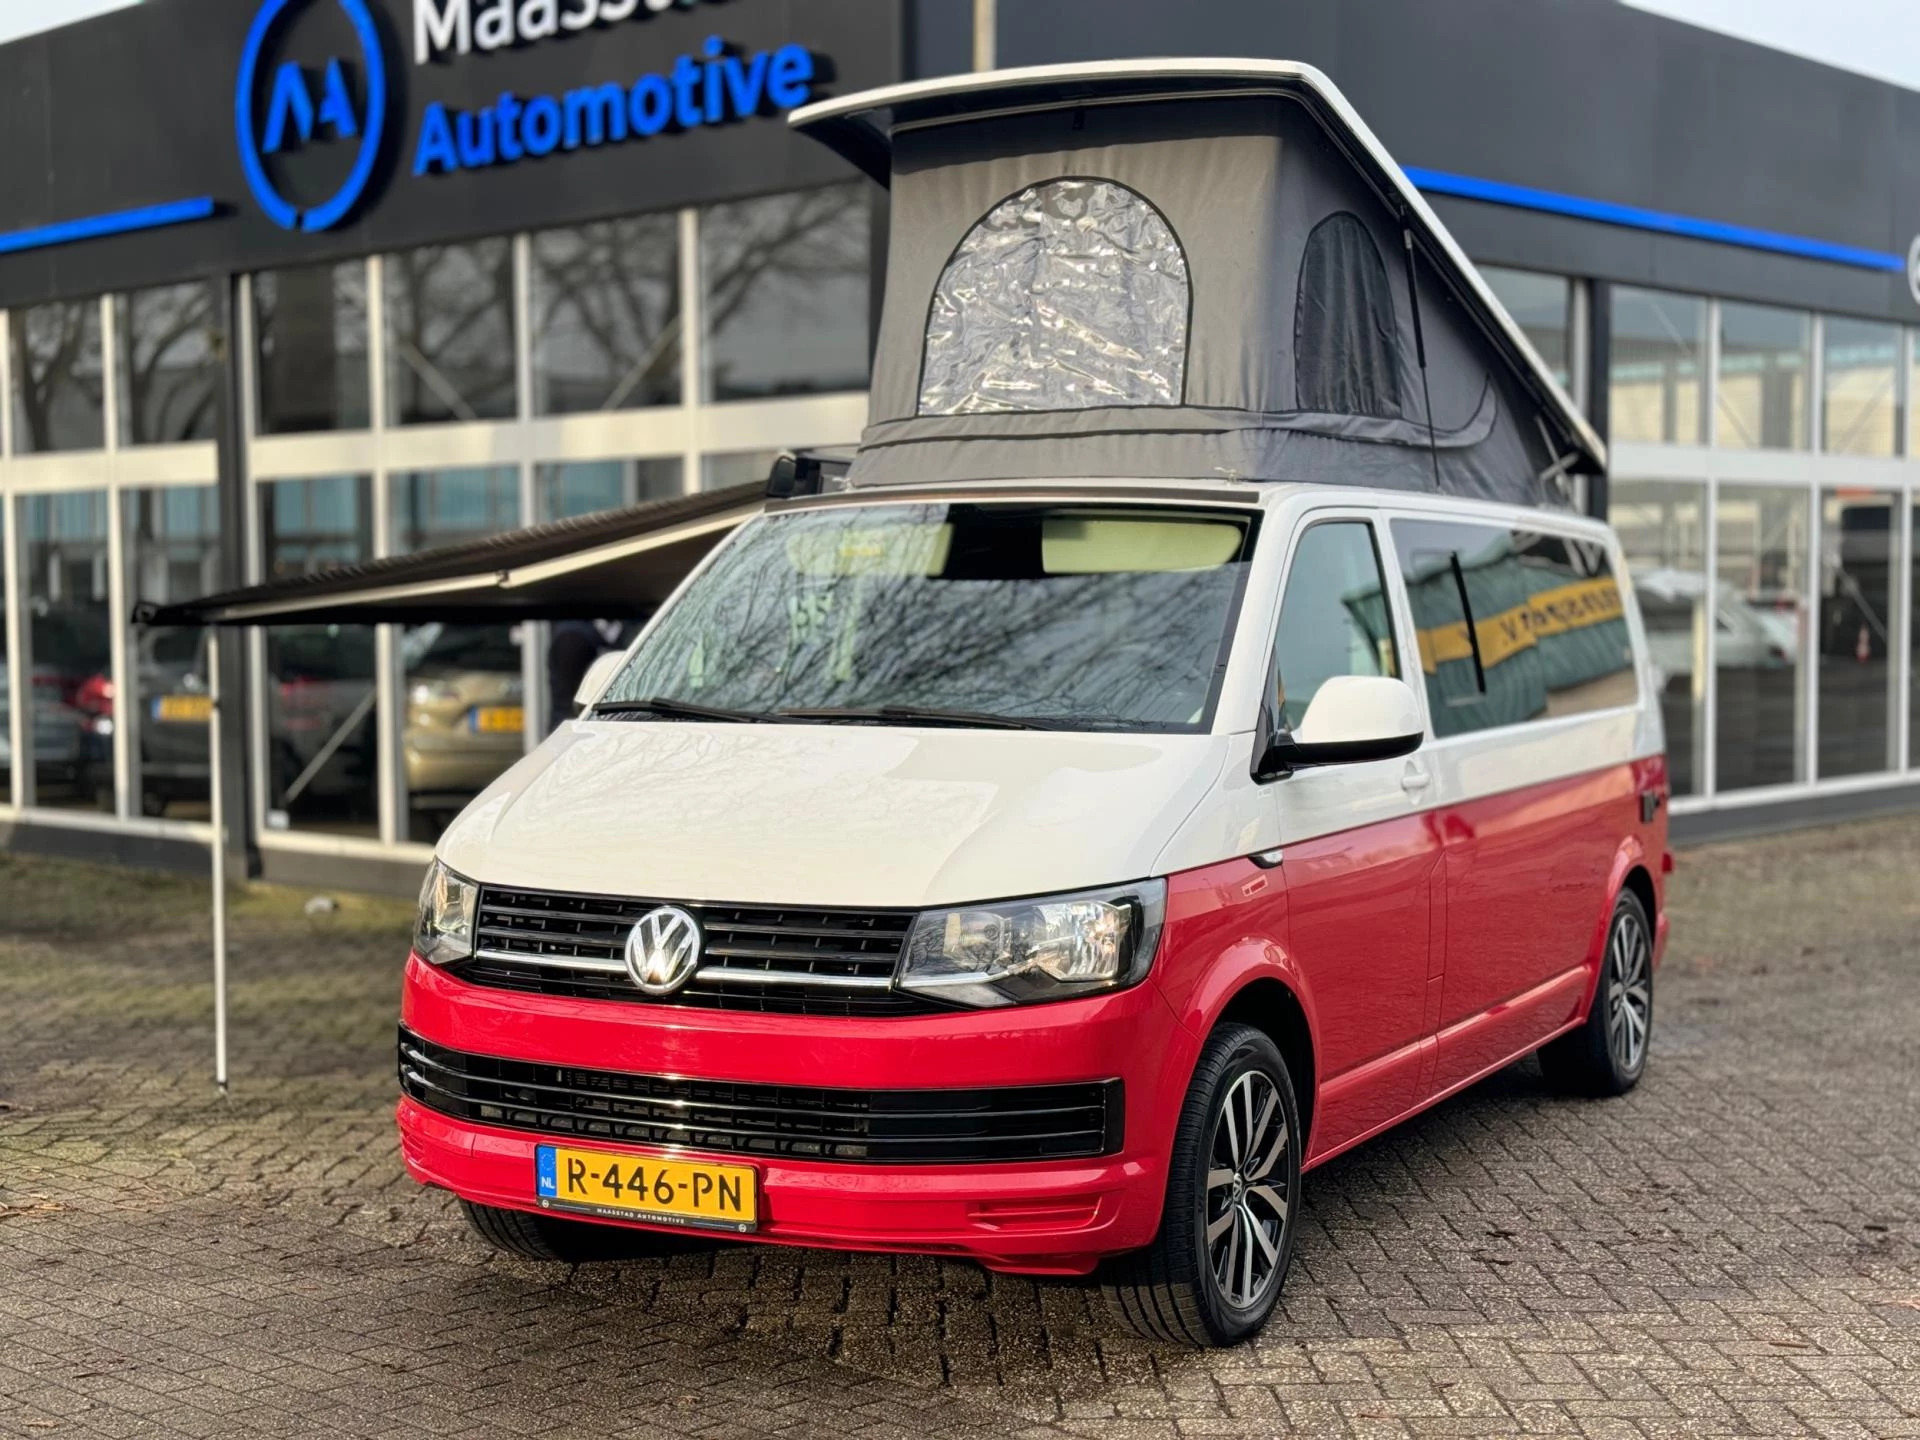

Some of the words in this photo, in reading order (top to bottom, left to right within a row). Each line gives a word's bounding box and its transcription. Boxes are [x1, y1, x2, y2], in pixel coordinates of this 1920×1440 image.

[412, 34, 814, 177] Automotive
[541, 1176, 555, 1189] NL
[567, 1157, 742, 1212] R-446-PN
[596, 1208, 634, 1218] MAASSTAD
[637, 1213, 685, 1224] AUTOMOTIVE
